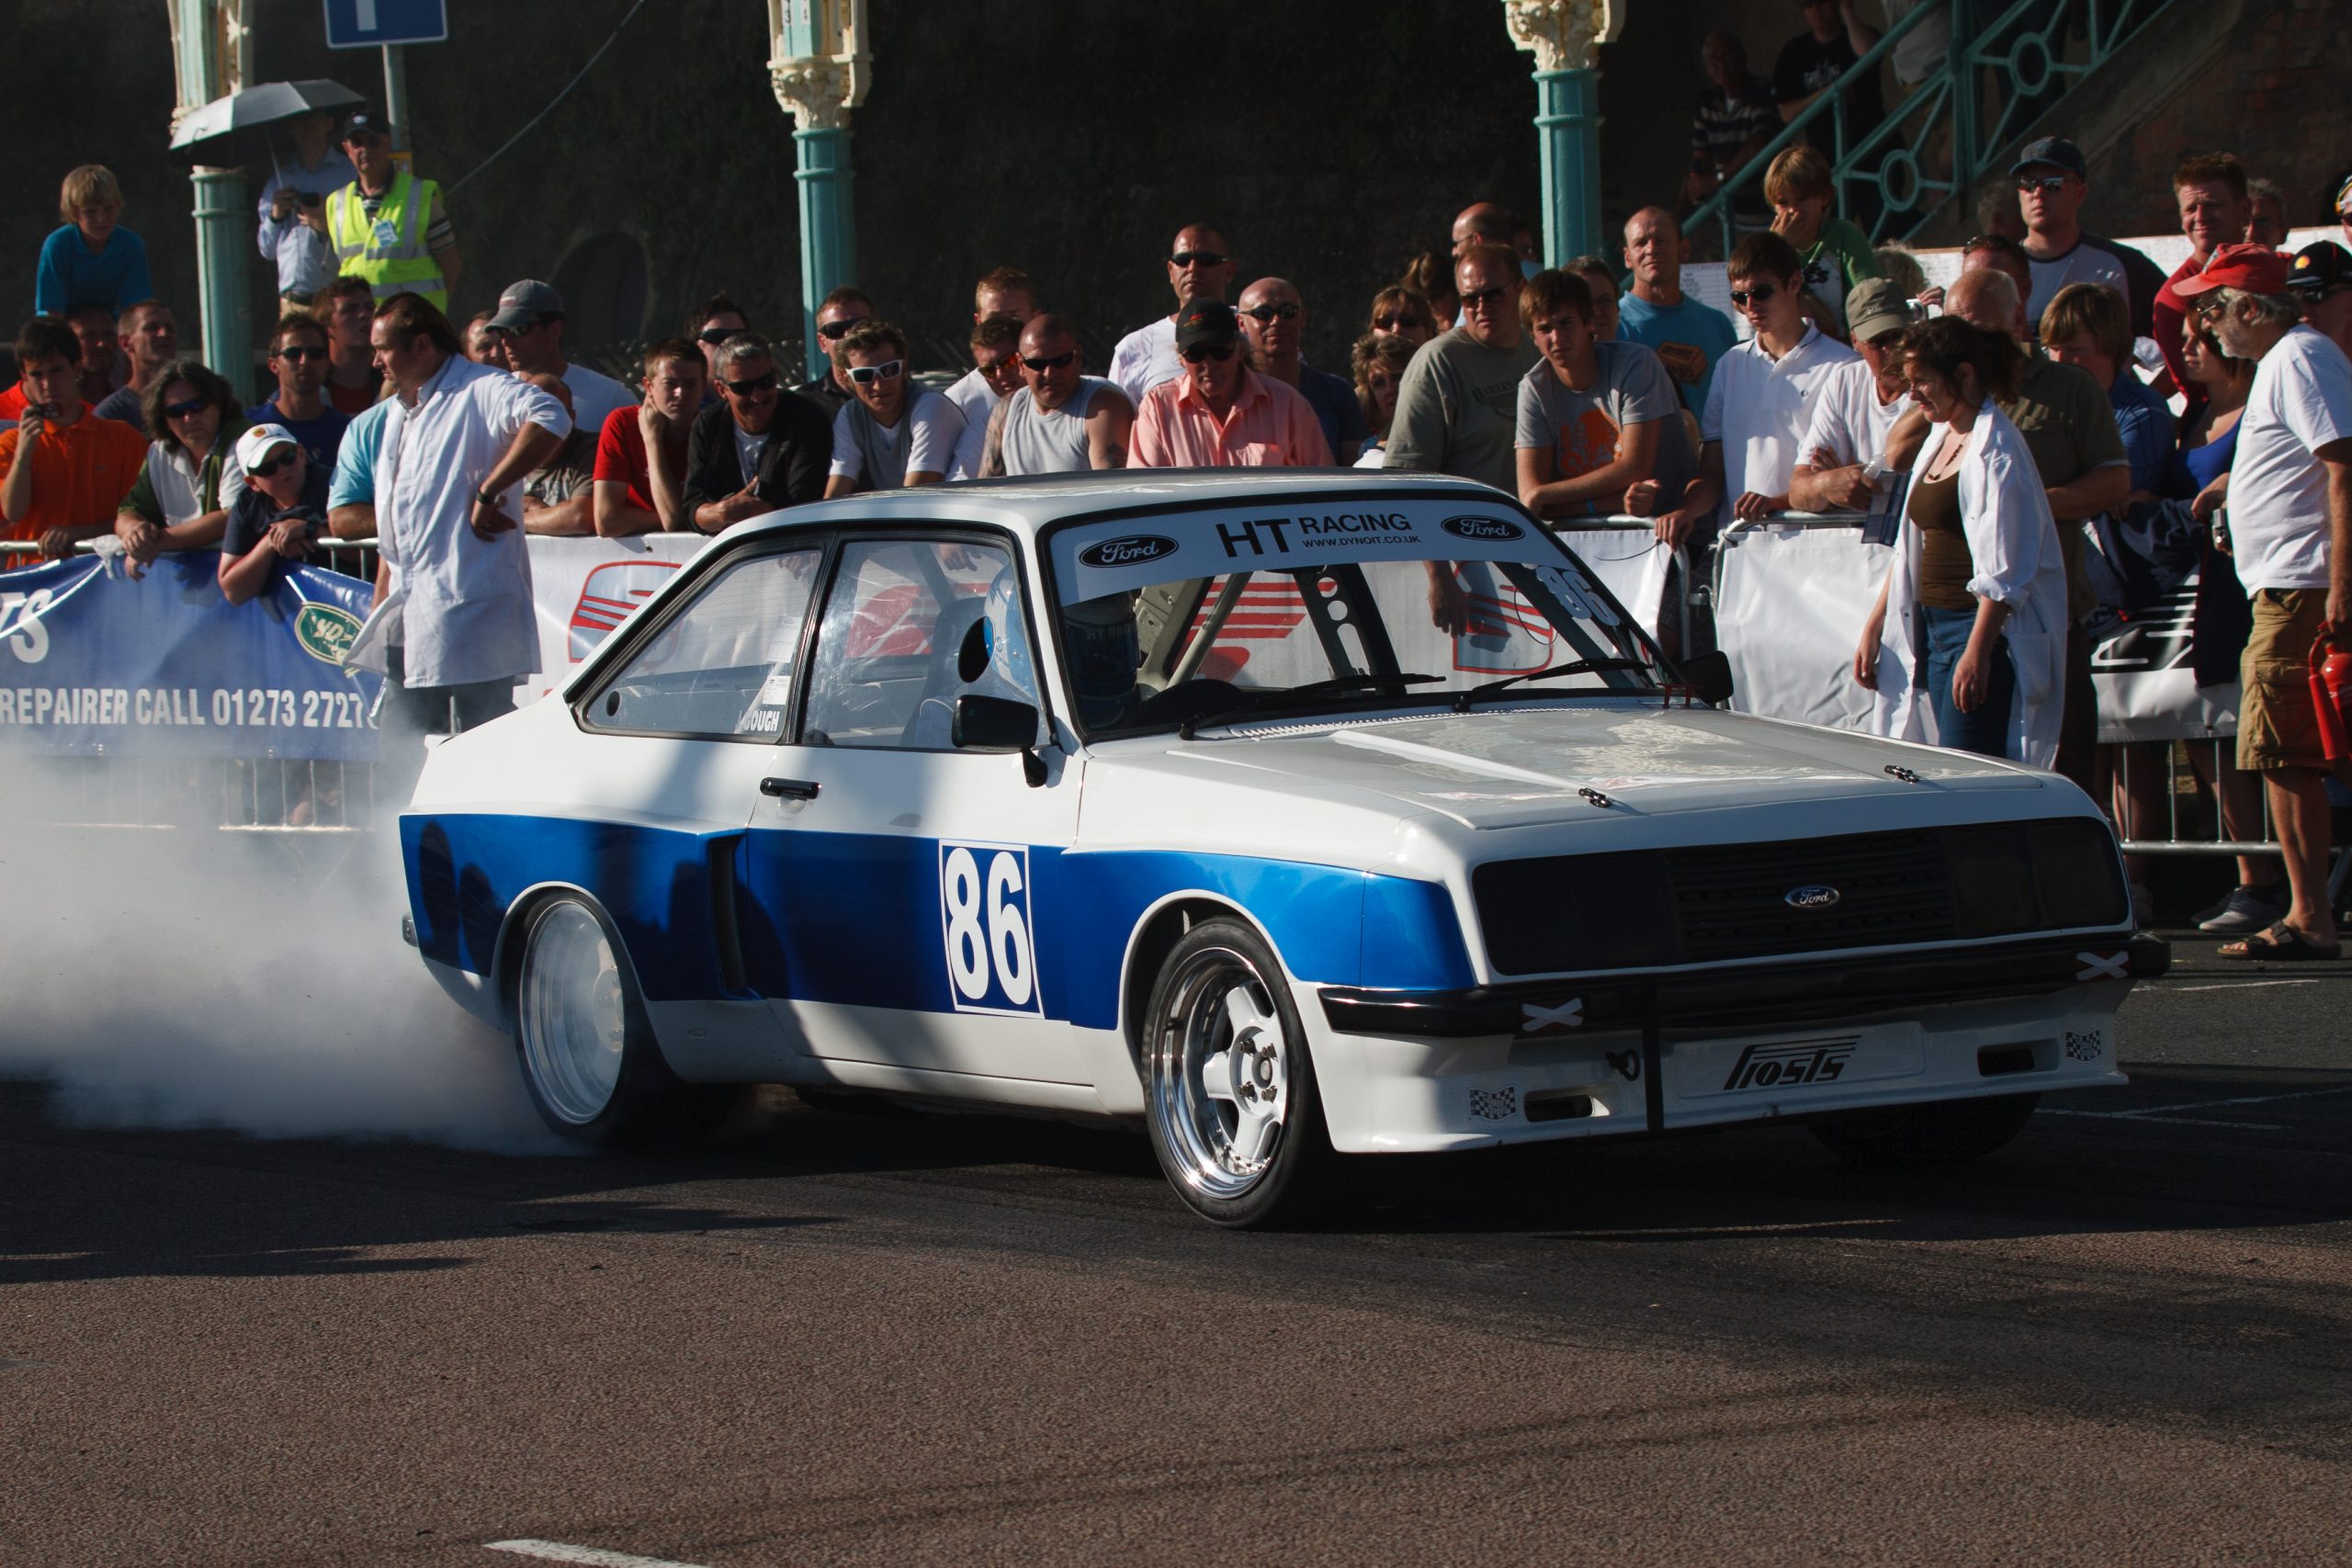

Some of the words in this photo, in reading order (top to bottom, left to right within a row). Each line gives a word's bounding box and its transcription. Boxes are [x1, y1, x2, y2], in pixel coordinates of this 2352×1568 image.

[1215, 518, 1291, 558] HT
[1297, 513, 1412, 535] RACING
[1302, 536, 1422, 548] WWW.DYNOIT.CO.UK
[1461, 519, 1510, 536] Ford
[1102, 539, 1159, 563] Ford
[1535, 566, 1621, 626] 86
[0, 688, 129, 725] REPAIRER
[135, 688, 206, 726] CALL
[212, 688, 296, 728] 01273
[1799, 888, 1829, 905] Ford
[944, 847, 1032, 1005] 86
[1723, 1034, 1861, 1090] Frosts
